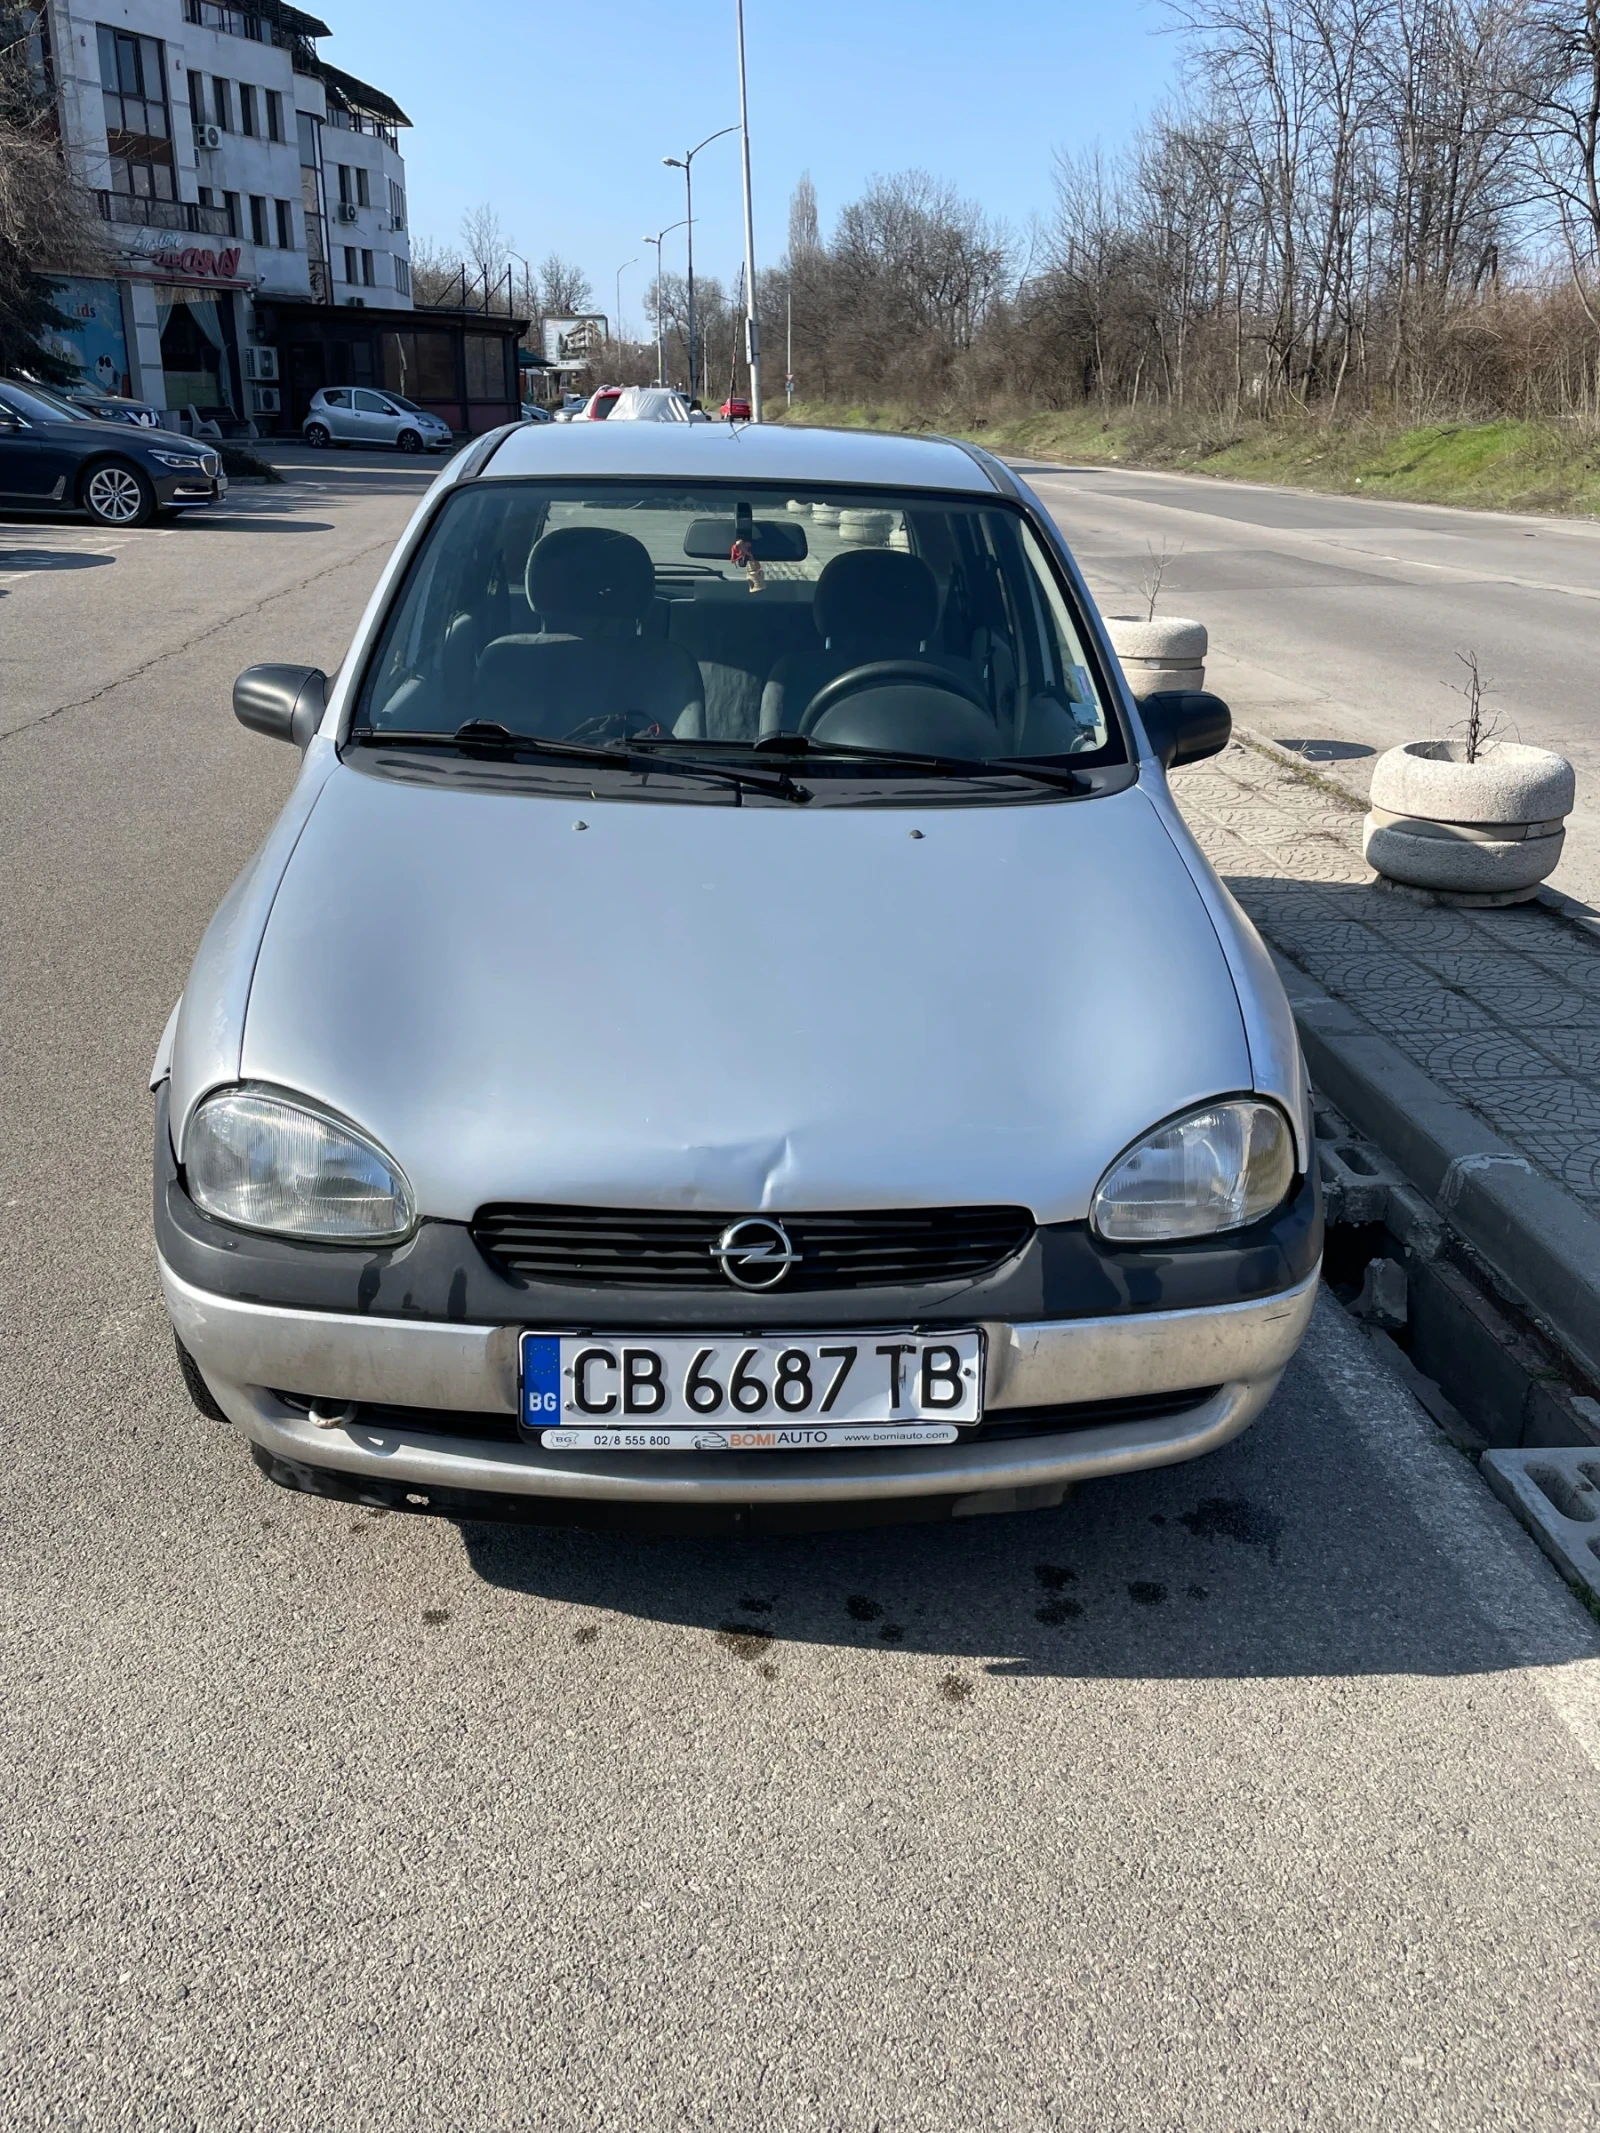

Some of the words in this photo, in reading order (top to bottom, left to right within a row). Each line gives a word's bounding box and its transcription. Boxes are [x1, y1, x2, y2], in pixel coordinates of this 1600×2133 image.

[529, 1392, 557, 1410] BG
[573, 1347, 666, 1414] CB
[683, 1346, 858, 1414] 6687
[875, 1344, 963, 1410] TB
[593, 1435, 621, 1447] 02/8
[625, 1435, 646, 1446] 555
[649, 1435, 671, 1446] 800
[844, 1431, 949, 1442] www.bomiauto.com
